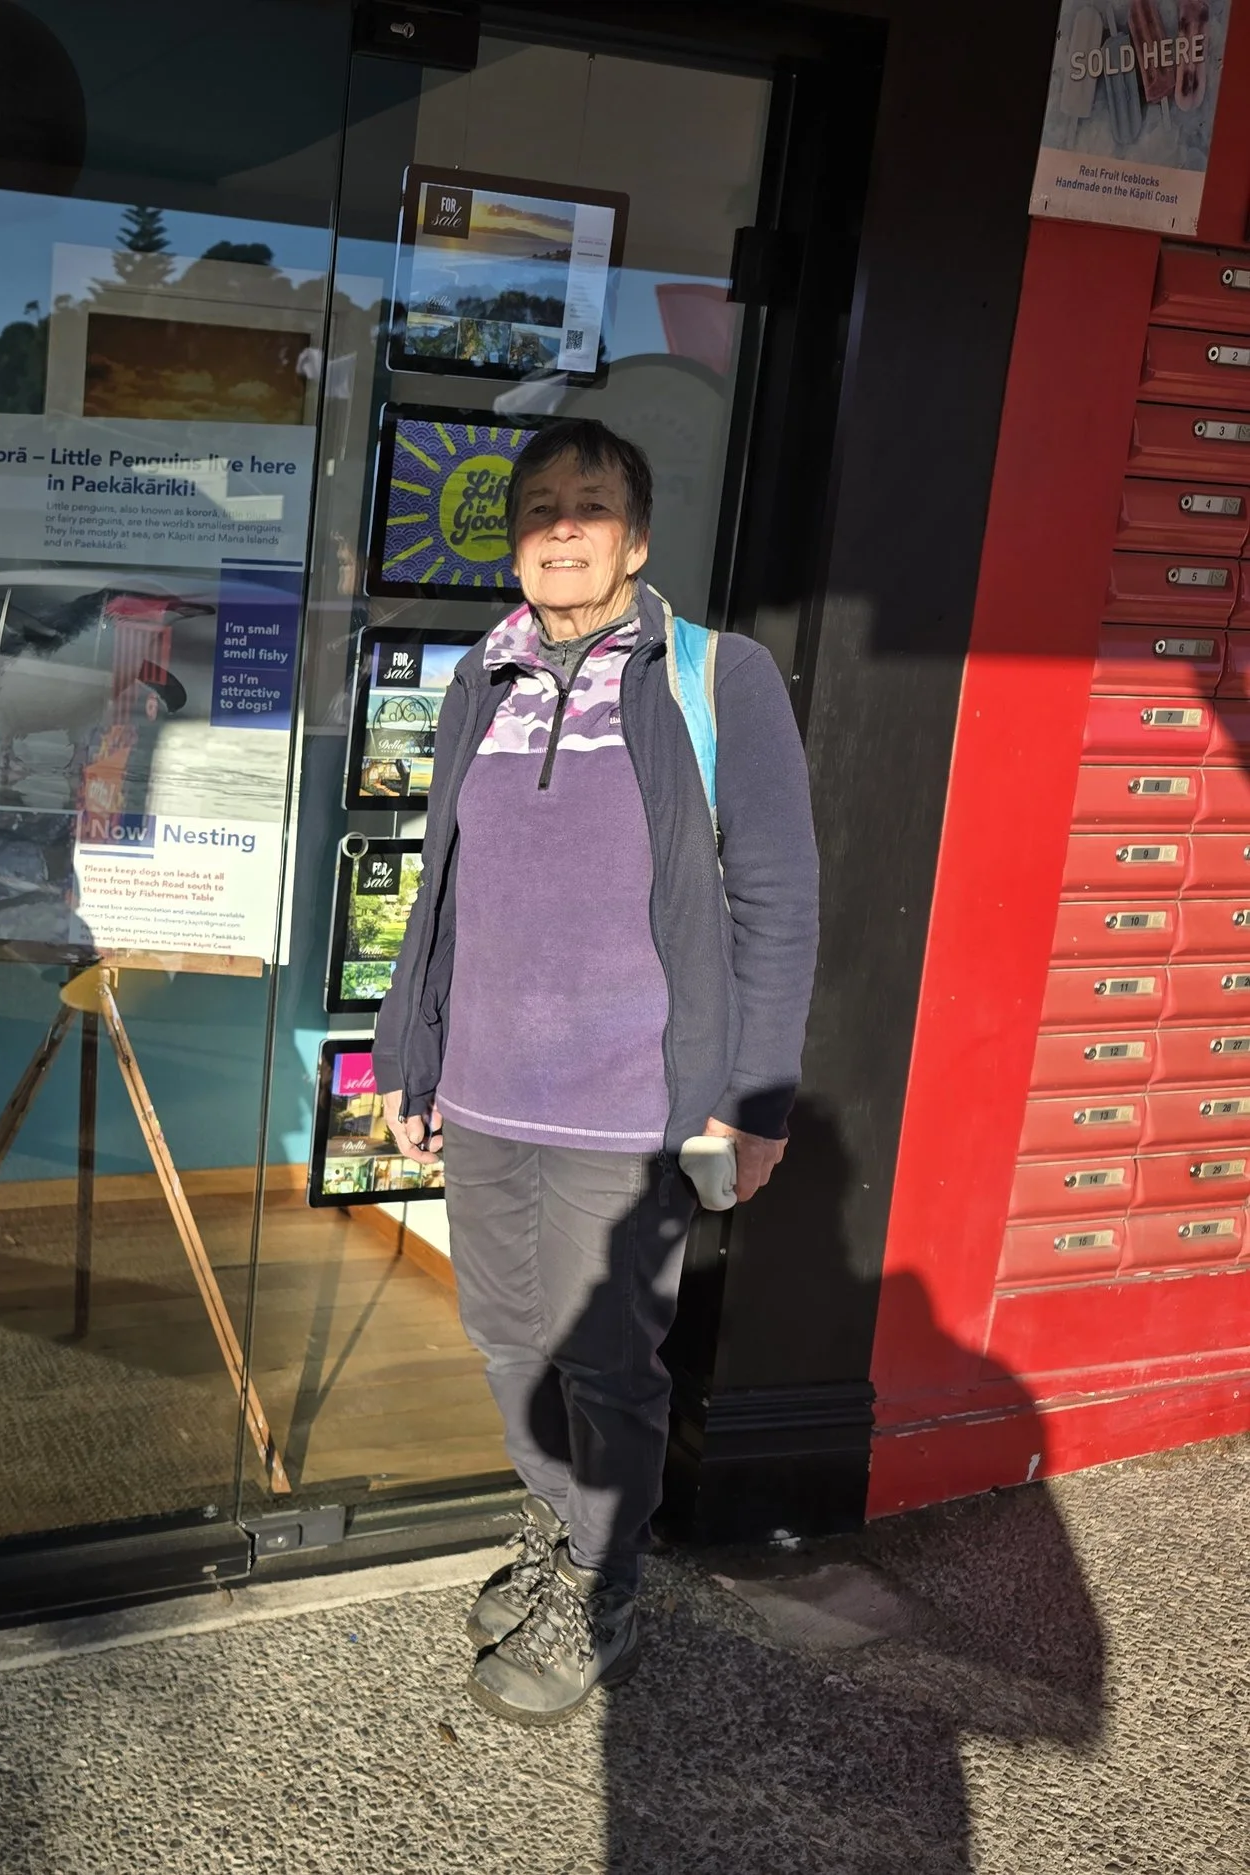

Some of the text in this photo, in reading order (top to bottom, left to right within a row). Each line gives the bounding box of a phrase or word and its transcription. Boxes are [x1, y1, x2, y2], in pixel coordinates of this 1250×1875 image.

[1070, 34, 1206, 81] SOLD HERE
[1079, 165, 1160, 187] Real Fruit Iceblocks
[1055, 176, 1178, 205] Handmade on the Kāpiti Coast
[441, 197, 457, 212] FOR
[431, 207, 462, 228] sale
[1232, 351, 1239, 361] 2
[1219, 426, 1225, 436] 3
[51, 447, 103, 466] Little
[109, 450, 202, 473] Penguins
[208, 453, 244, 472] live
[250, 455, 298, 475] here
[47, 474, 196, 497] in Paekākāriki!
[462, 469, 510, 507] Lif
[46, 501, 69, 511] Little
[71, 503, 118, 515] penguins,
[120, 505, 138, 514] also
[141, 506, 171, 516] known
[174, 508, 184, 516] as
[187, 508, 220, 519] kororā,
[476, 500, 488, 513] is
[1206, 500, 1212, 509] 4
[45, 514, 56, 522] or
[58, 513, 77, 525] fairy
[79, 514, 126, 527] penguins,
[128, 518, 141, 526] are
[145, 517, 159, 527] the
[197, 521, 235, 531] smallest
[45, 525, 279, 545] They live mostly at sea, on Kāpiti and Mana Islands
[44, 538, 61, 547] and
[63, 539, 72, 547] in
[1191, 572, 1197, 582] 5
[247, 623, 280, 635] small
[223, 634, 247, 646] and
[1179, 643, 1184, 653] 6
[223, 647, 288, 664] smell fishy
[392, 652, 409, 666] FOR
[383, 659, 414, 680] sale
[221, 674, 236, 684] so
[221, 686, 281, 699] attractive
[220, 698, 273, 713] to dogs!
[1167, 712, 1173, 722] 7
[90, 818, 257, 853] Now Nesting
[84, 864, 112, 873] Please
[115, 866, 137, 877] keep
[139, 868, 161, 878] dogs
[177, 870, 200, 879] leads
[214, 872, 225, 880] all
[372, 862, 388, 875] FOR
[84, 875, 107, 884] times
[110, 876, 131, 885] from
[134, 878, 160, 887] Beach
[162, 880, 185, 889] Road
[187, 882, 212, 891] south
[363, 868, 393, 889] sale
[83, 885, 215, 902] the rocks by Fishermans Table
[1131, 917, 1139, 926] 10
[1120, 983, 1128, 992] 11
[1110, 1047, 1118, 1056] 12
[1233, 1042, 1242, 1051] 27
[345, 1069, 376, 1089] sold
[1100, 1112, 1108, 1121] 13
[1213, 1166, 1222, 1175] 29
[1090, 1175, 1098, 1184] 14
[1201, 1225, 1210, 1234] 30
[1079, 1237, 1087, 1246] 15
